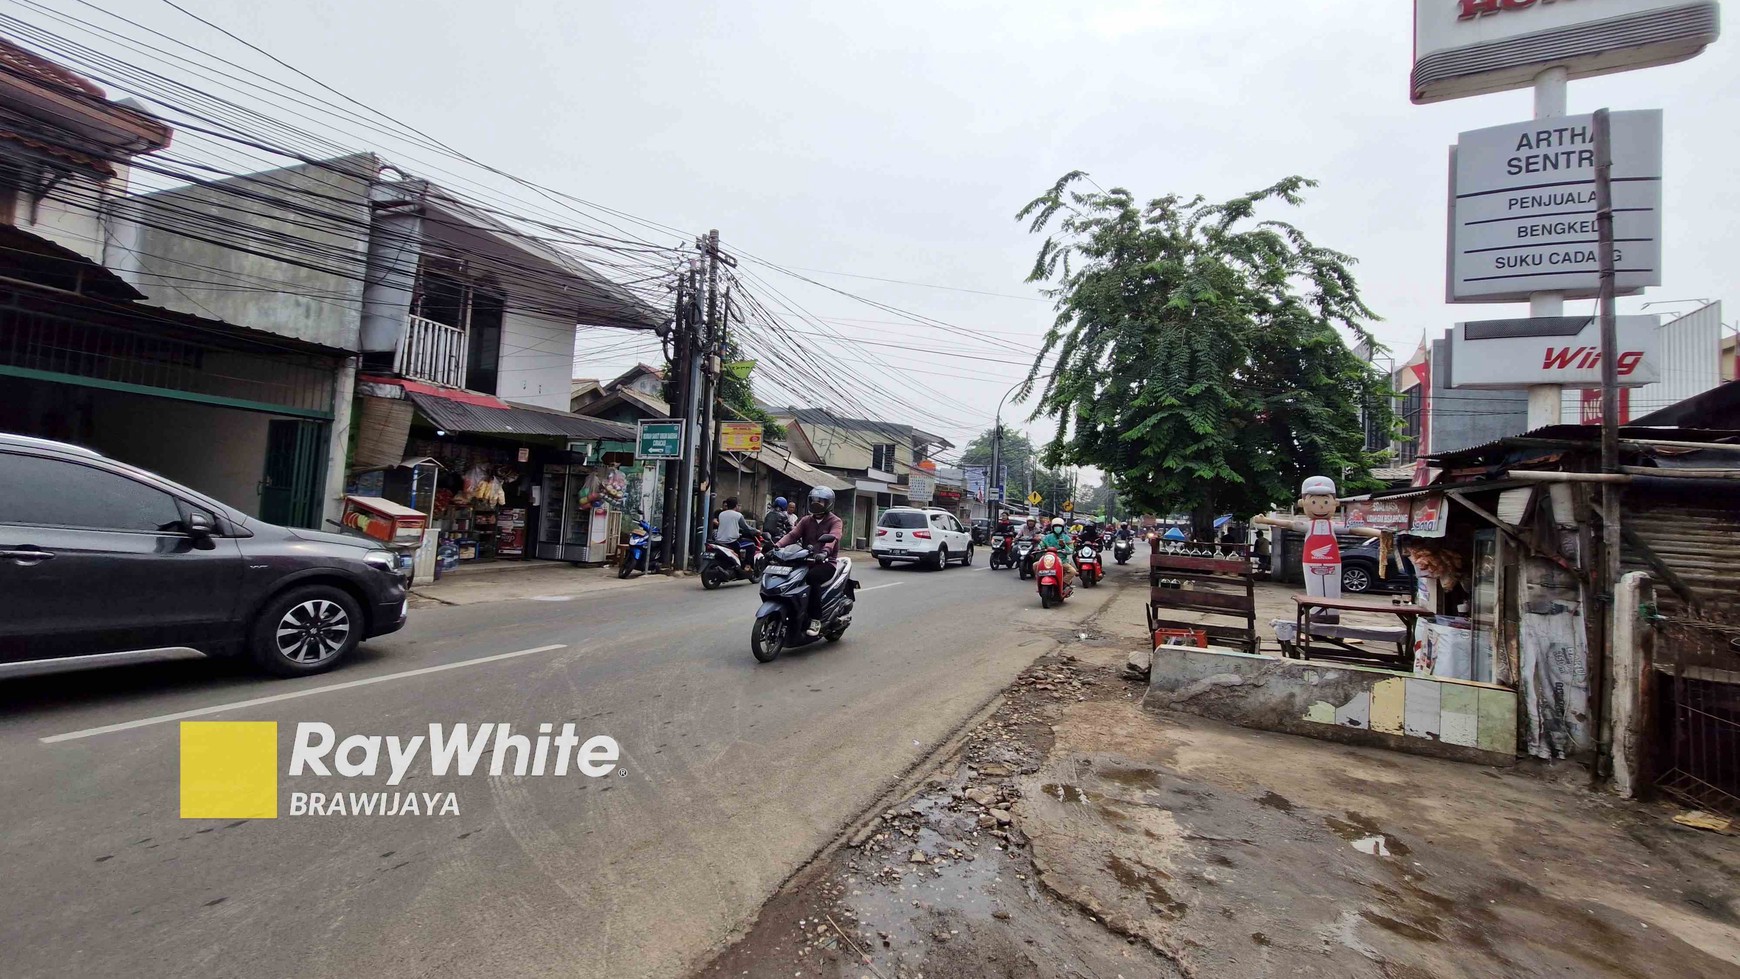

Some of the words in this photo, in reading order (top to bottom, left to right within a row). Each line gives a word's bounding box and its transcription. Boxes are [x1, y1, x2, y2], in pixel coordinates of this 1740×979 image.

[1507, 149, 1594, 176] SENTR
[1508, 190, 1597, 210] PENJUALA
[1495, 253, 1543, 269] SUKU
[1548, 249, 1622, 265] CADAG
